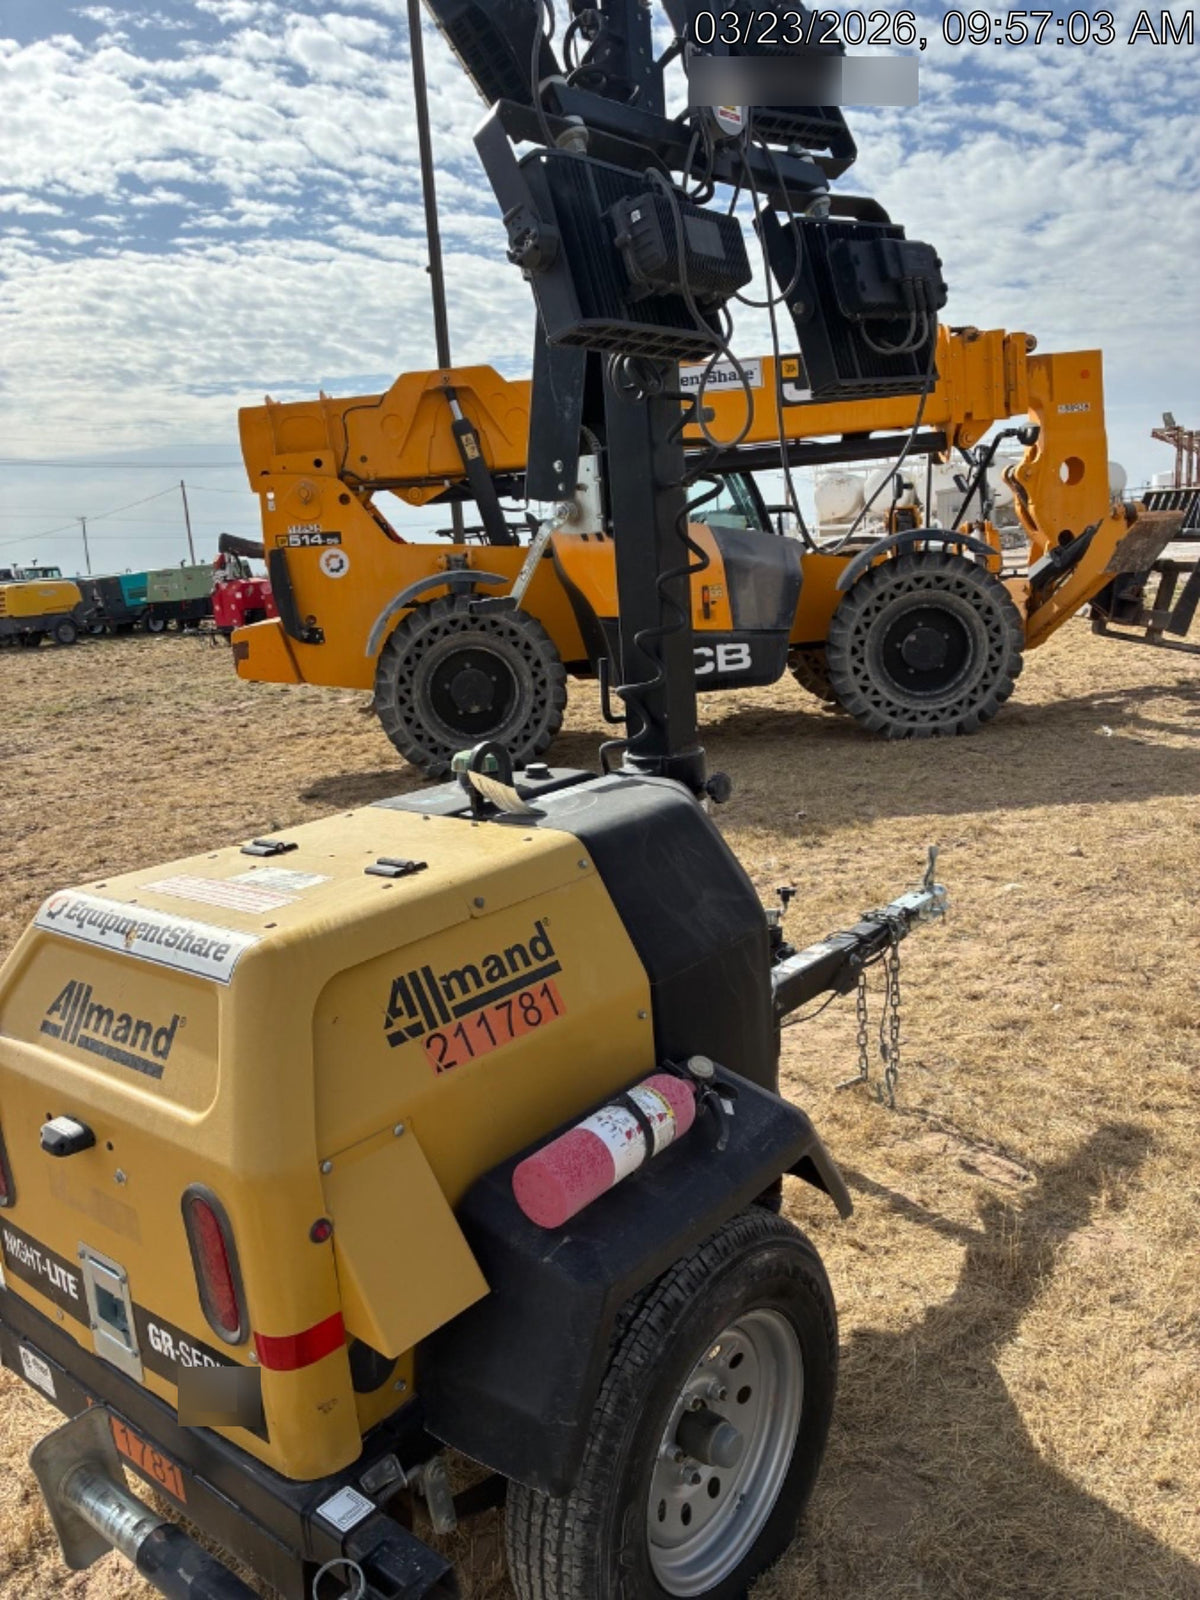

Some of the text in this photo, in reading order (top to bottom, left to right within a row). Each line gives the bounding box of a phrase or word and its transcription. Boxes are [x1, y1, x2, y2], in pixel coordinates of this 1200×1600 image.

[693, 643, 752, 674] CB
[65, 901, 231, 962] EquipmentShare
[384, 919, 556, 1032] Allmand
[46, 979, 181, 1061] Allmand
[425, 983, 560, 1073] 211781
[147, 1322, 226, 1367] GR-SE
[119, 1426, 181, 1497] 1781
